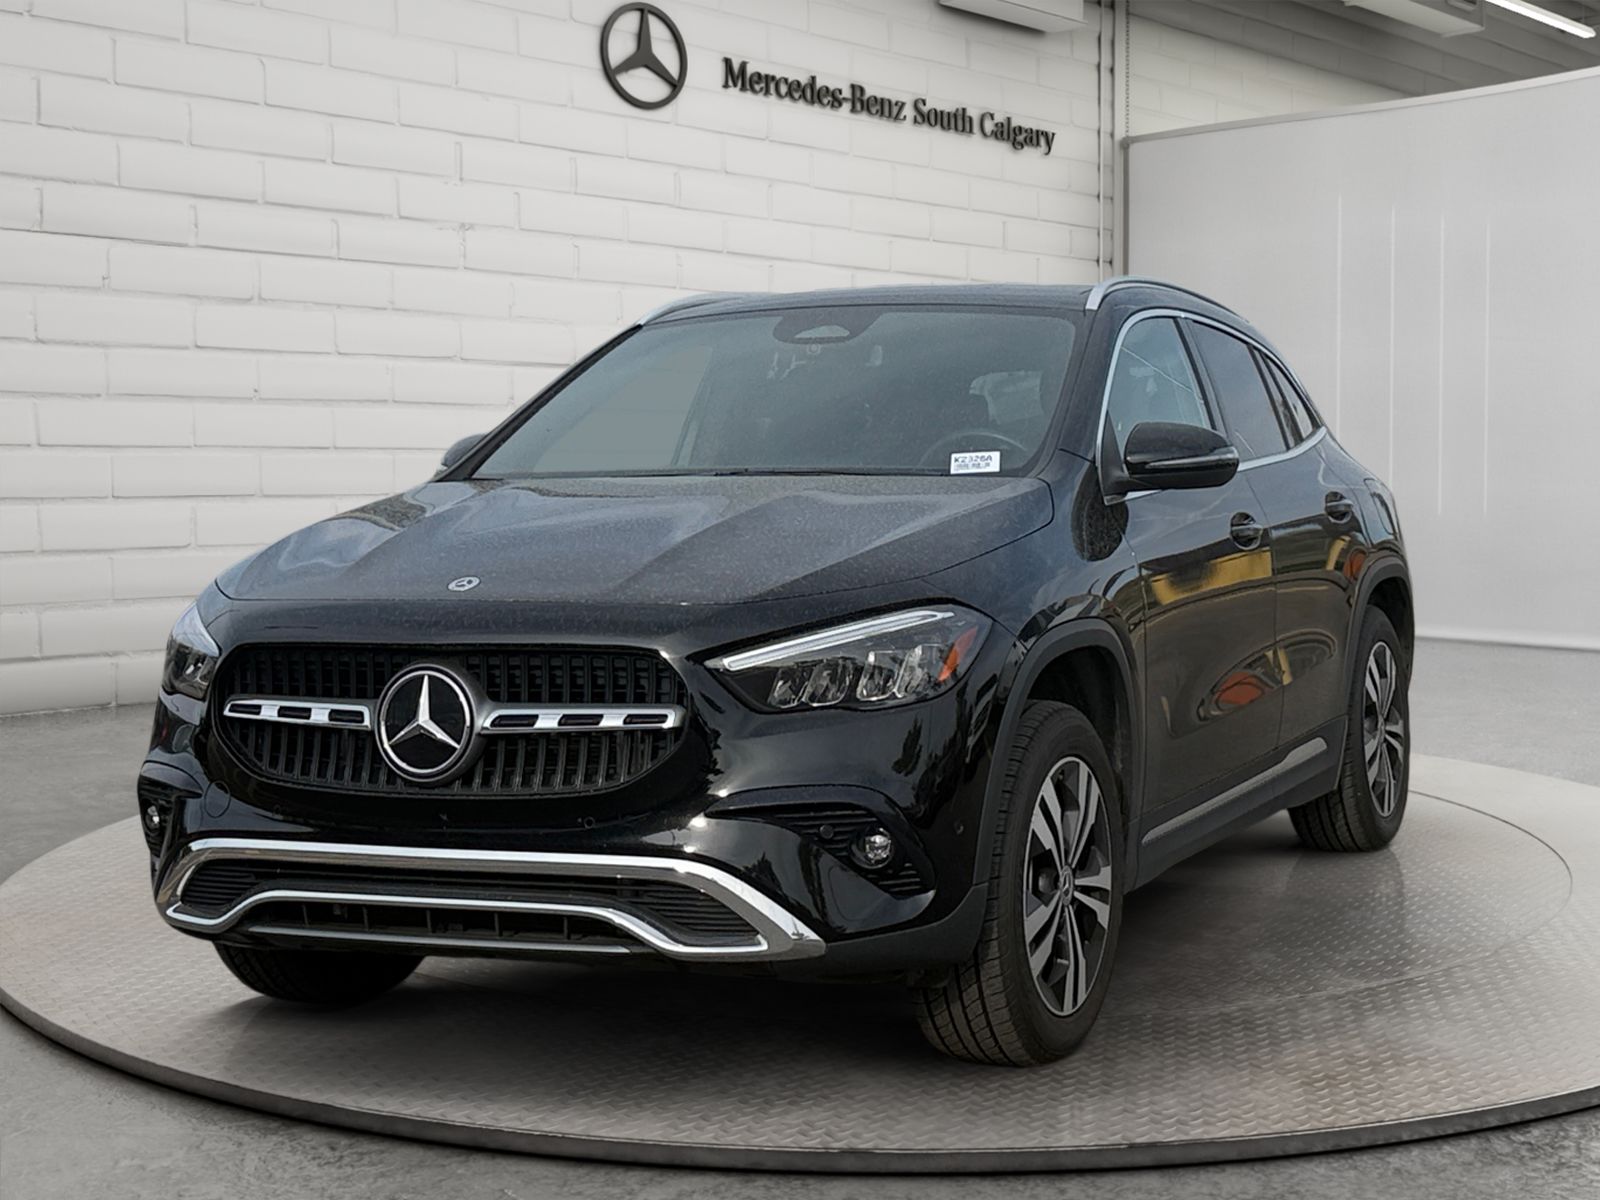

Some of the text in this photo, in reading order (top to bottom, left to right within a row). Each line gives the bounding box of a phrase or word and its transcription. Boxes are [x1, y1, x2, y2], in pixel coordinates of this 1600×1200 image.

[722, 56, 1056, 156] Mercedes-Benz South Calgary
